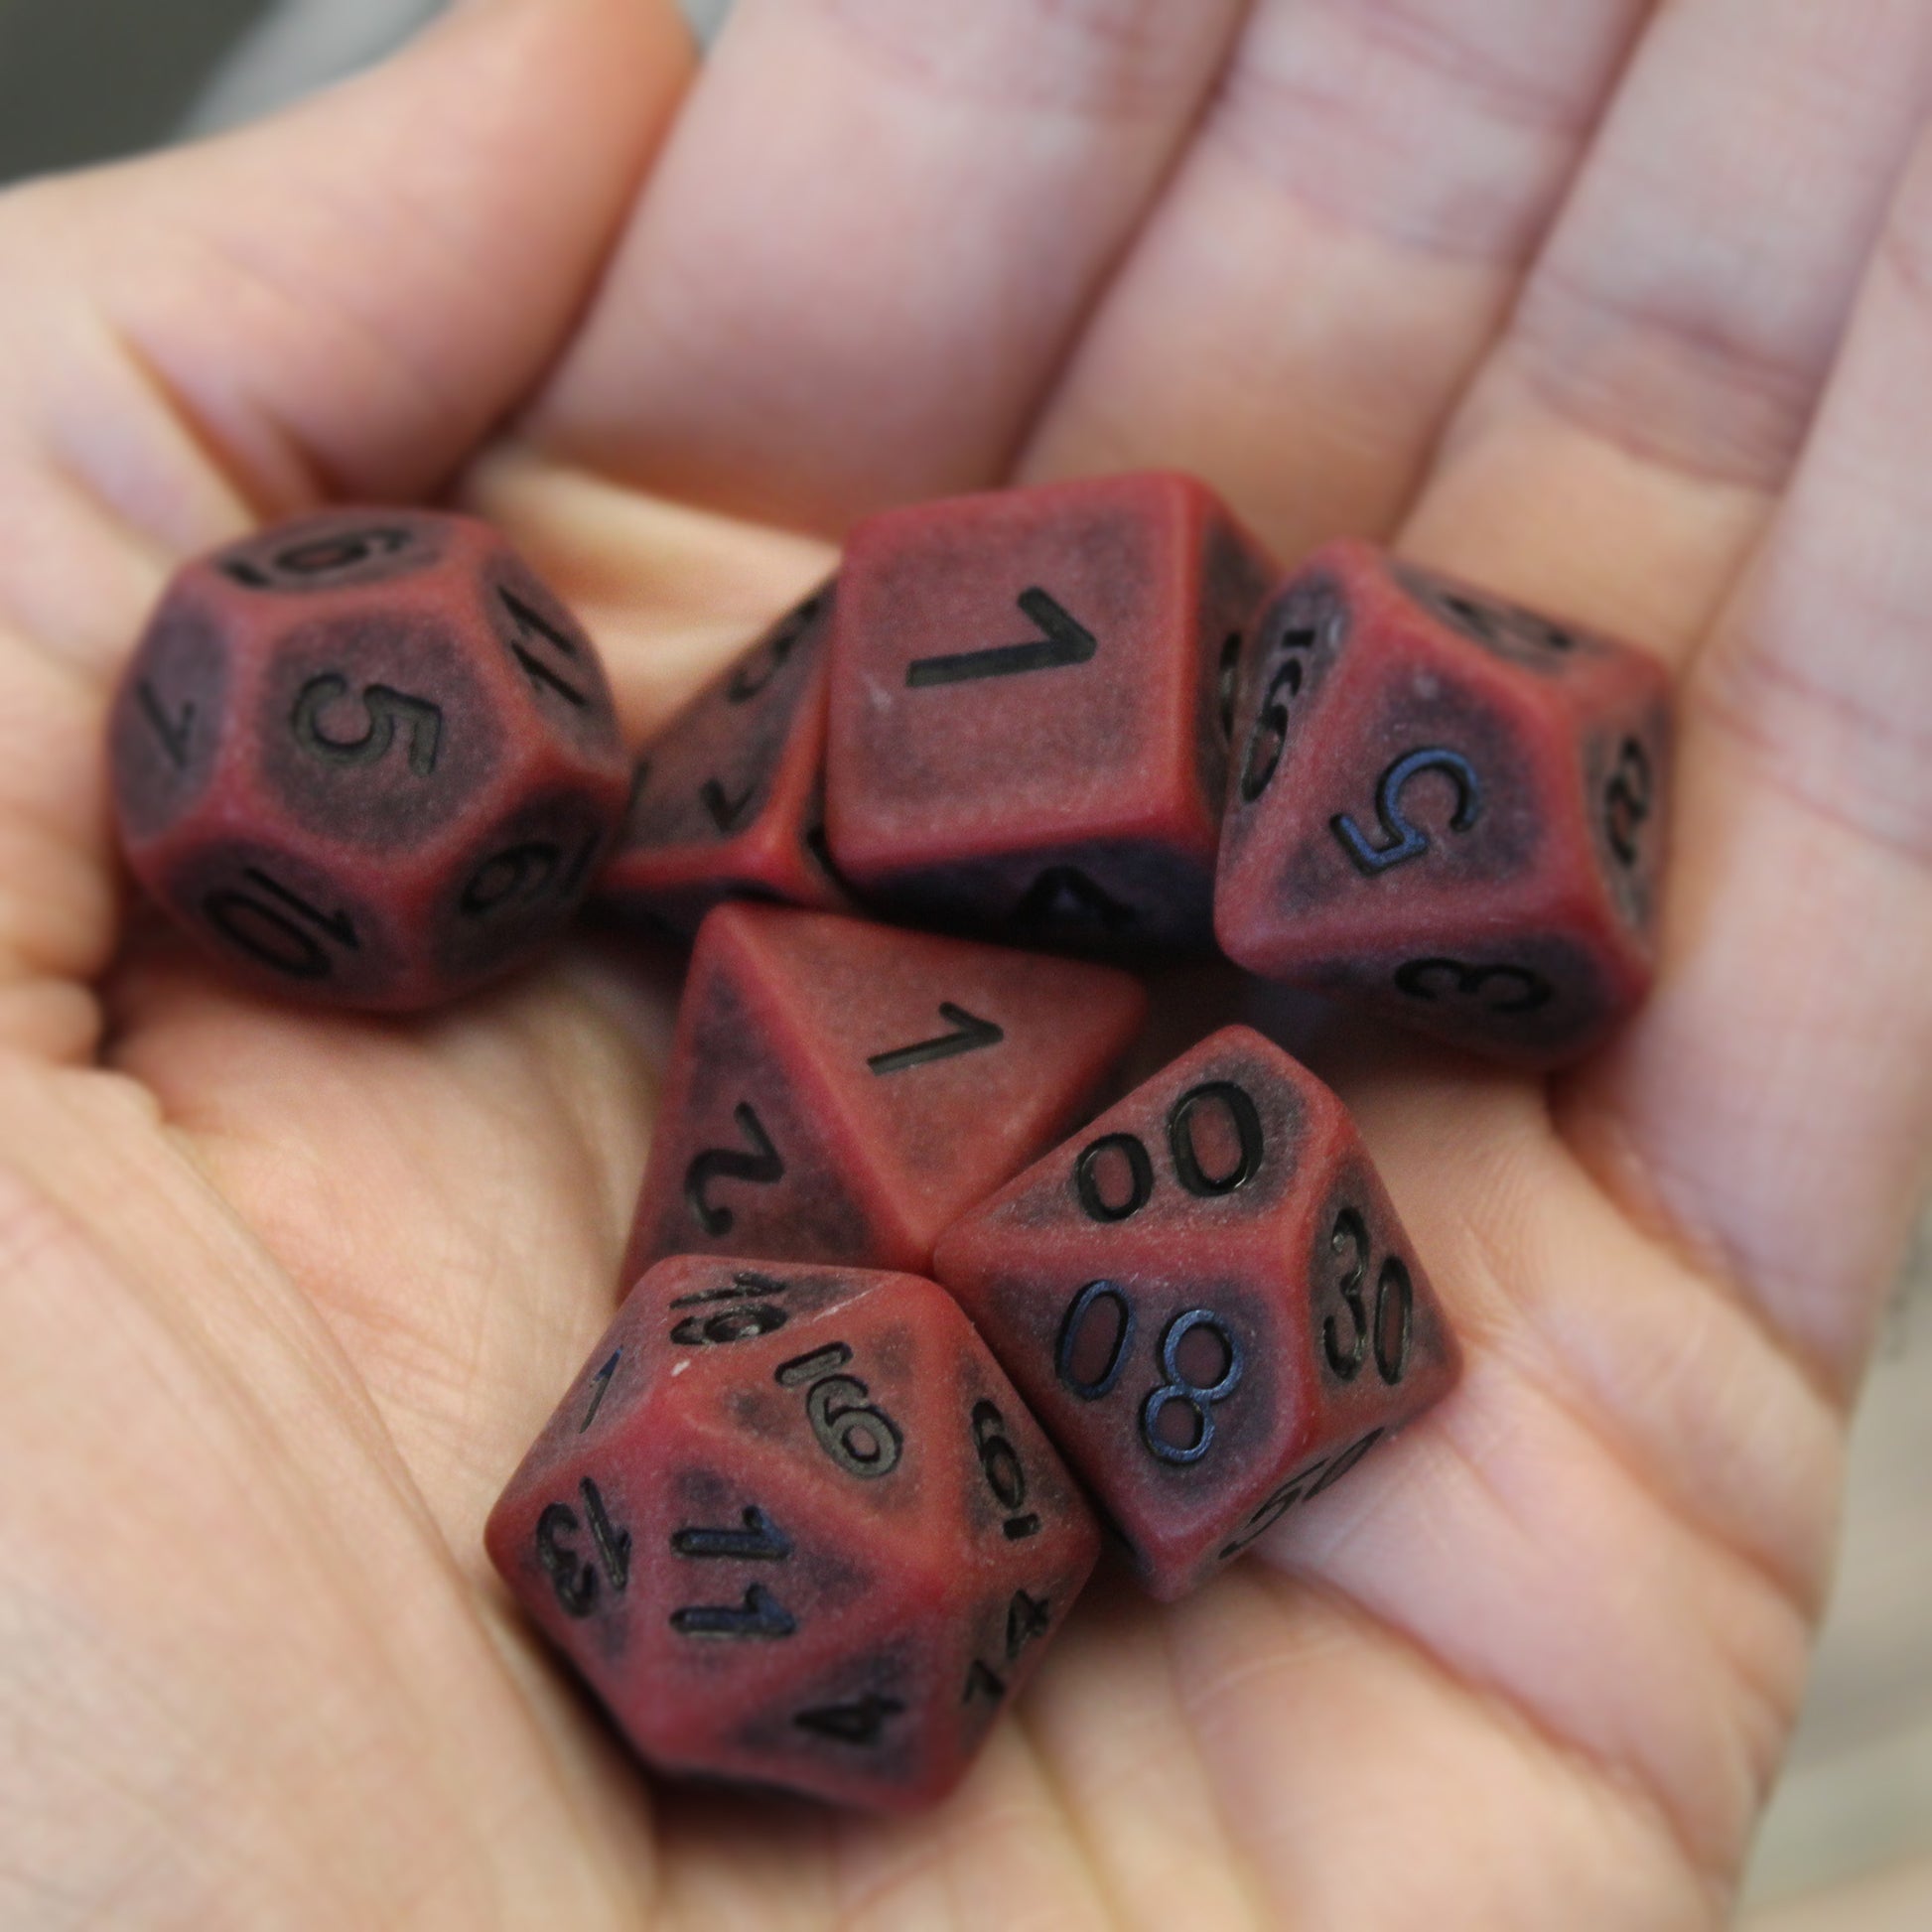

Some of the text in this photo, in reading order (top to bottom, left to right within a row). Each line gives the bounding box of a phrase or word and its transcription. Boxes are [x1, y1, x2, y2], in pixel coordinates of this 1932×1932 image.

[497, 585, 587, 707] 11
[903, 586, 1097, 687] 1
[292, 673, 442, 777] 5
[1329, 747, 1481, 877] 5
[203, 868, 359, 979] 10
[867, 1002, 1005, 1077] 1
[1394, 956, 1553, 1012] 3
[684, 1102, 784, 1236] 2
[1073, 1080, 1264, 1223] 00
[1322, 1207, 1413, 1386] 30
[536, 1476, 631, 1617] 13
[669, 1504, 795, 1639] 11
[960, 1588, 1050, 1703] 14
[793, 1695, 903, 1745] 4
